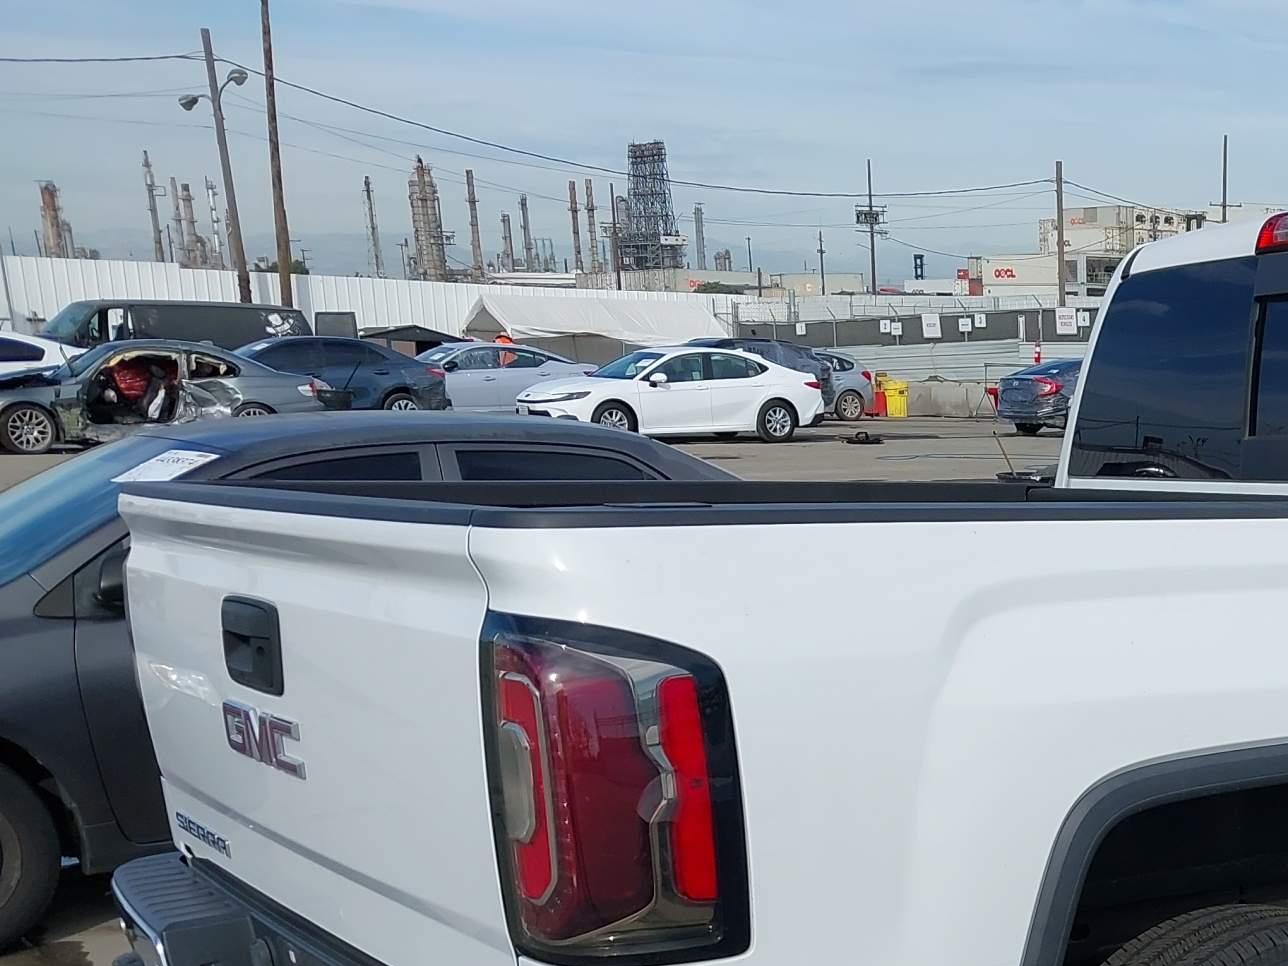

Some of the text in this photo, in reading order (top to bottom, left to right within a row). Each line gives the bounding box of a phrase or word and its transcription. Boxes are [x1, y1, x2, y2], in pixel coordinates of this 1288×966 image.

[994, 268, 1016, 279] OOCL
[222, 699, 307, 781] GMC
[175, 811, 232, 859] SIERRA
